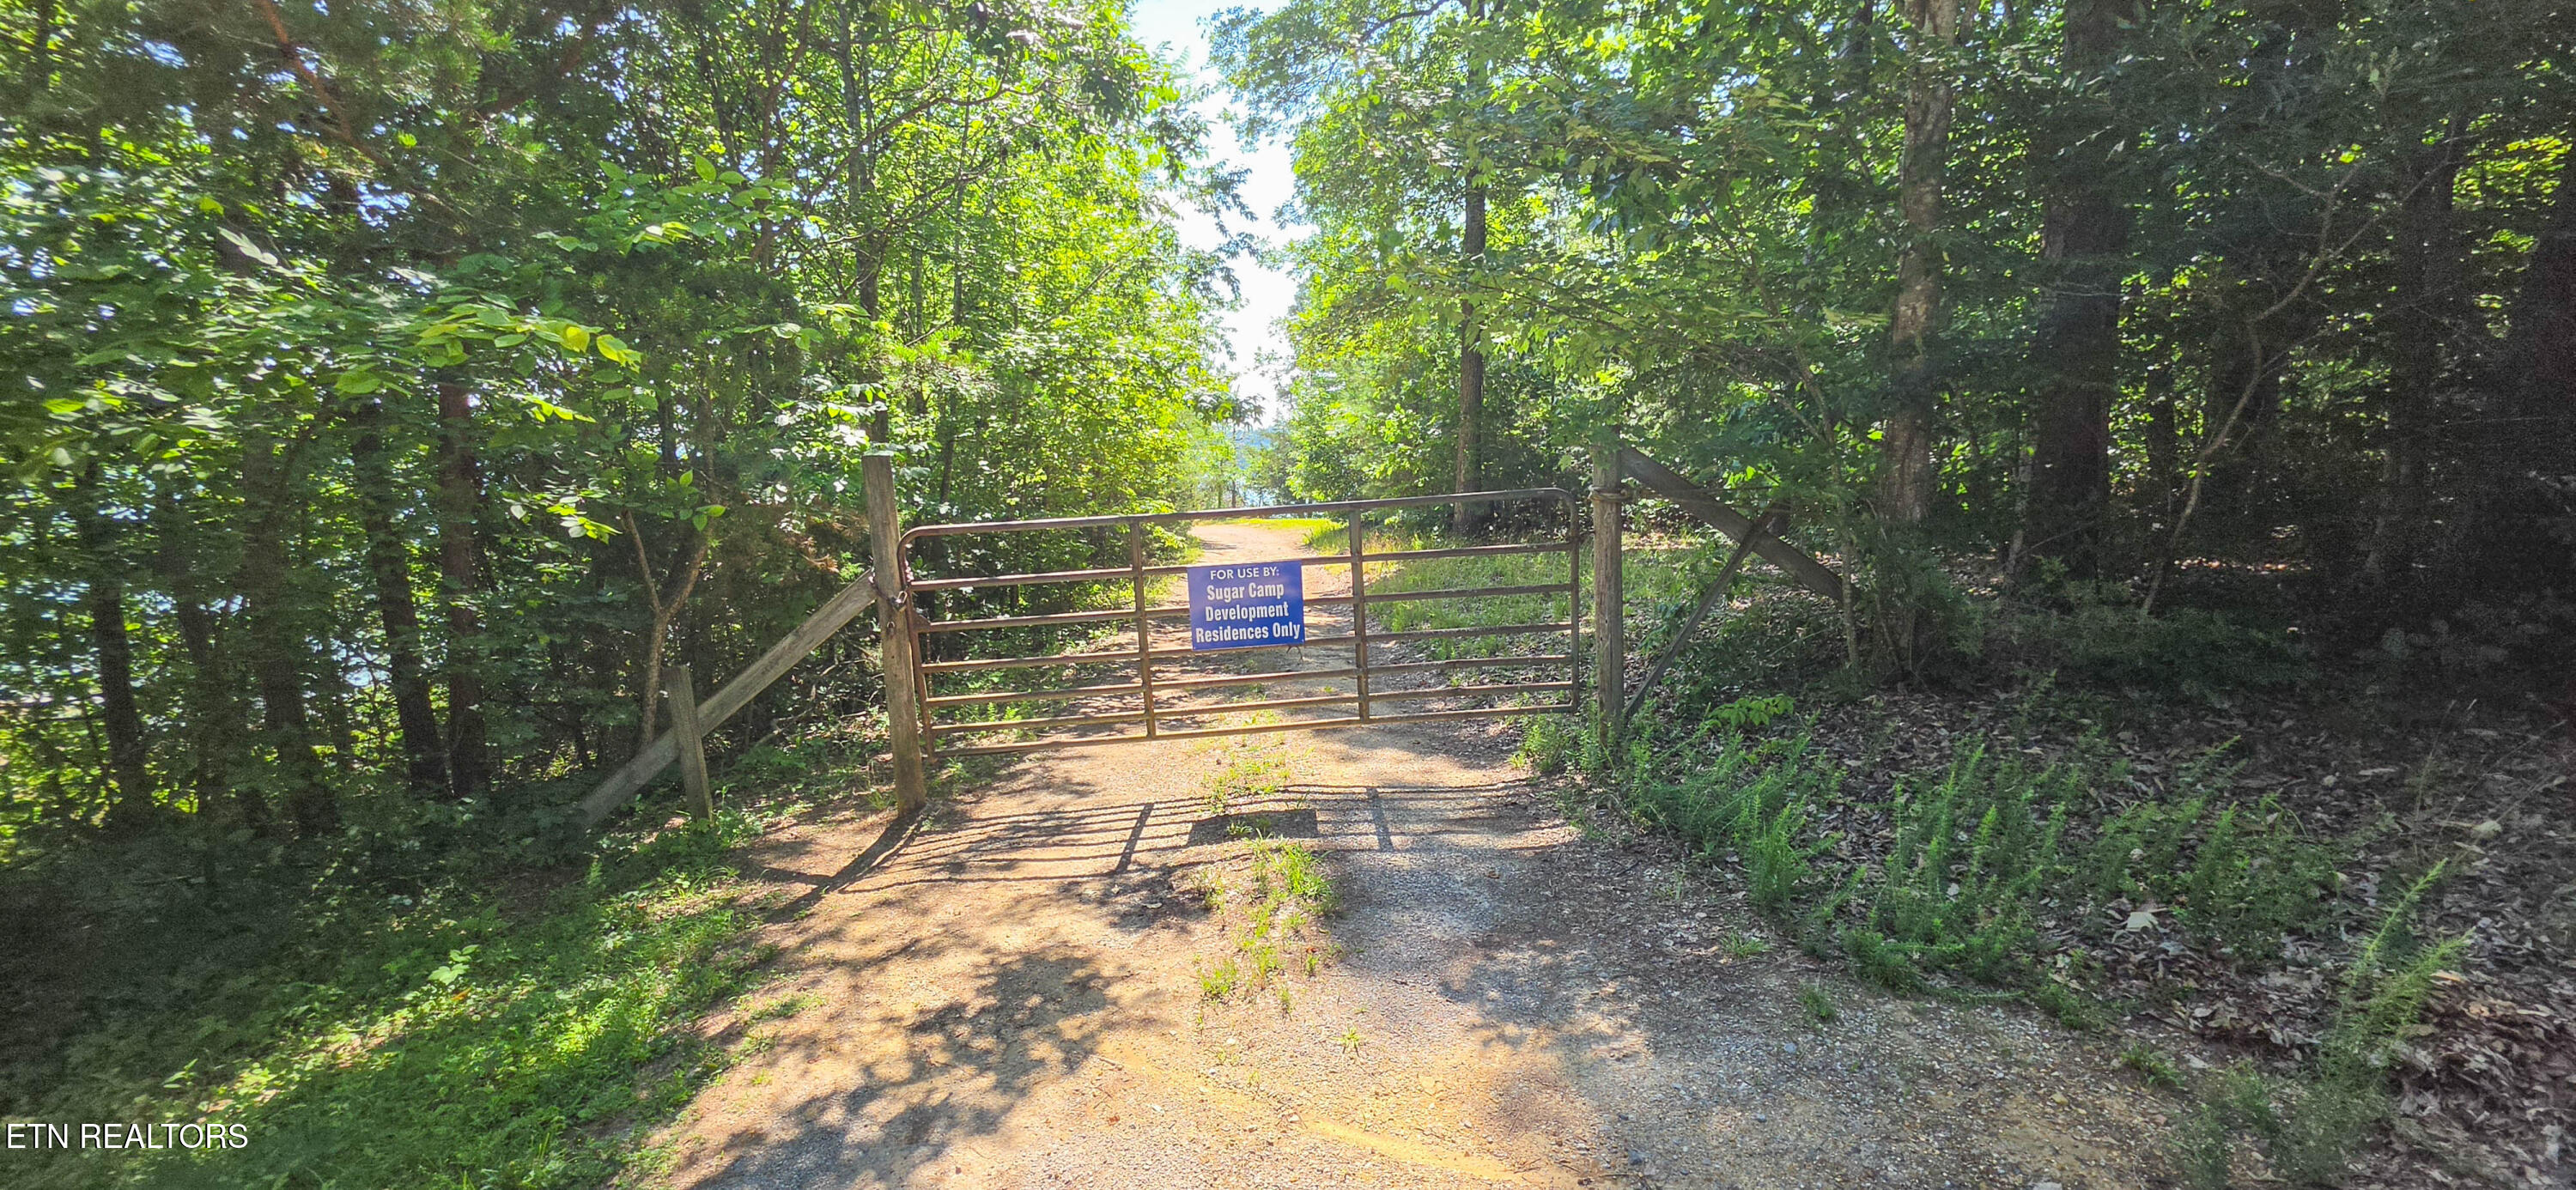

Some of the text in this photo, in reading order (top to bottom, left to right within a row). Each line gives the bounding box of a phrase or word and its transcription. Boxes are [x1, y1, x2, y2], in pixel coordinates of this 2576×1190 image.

[1210, 567, 1279, 580] FOR USE BY:
[1206, 582, 1285, 603] Sugar Camp
[1205, 601, 1289, 622] Development
[1195, 622, 1301, 643] Residences Only
